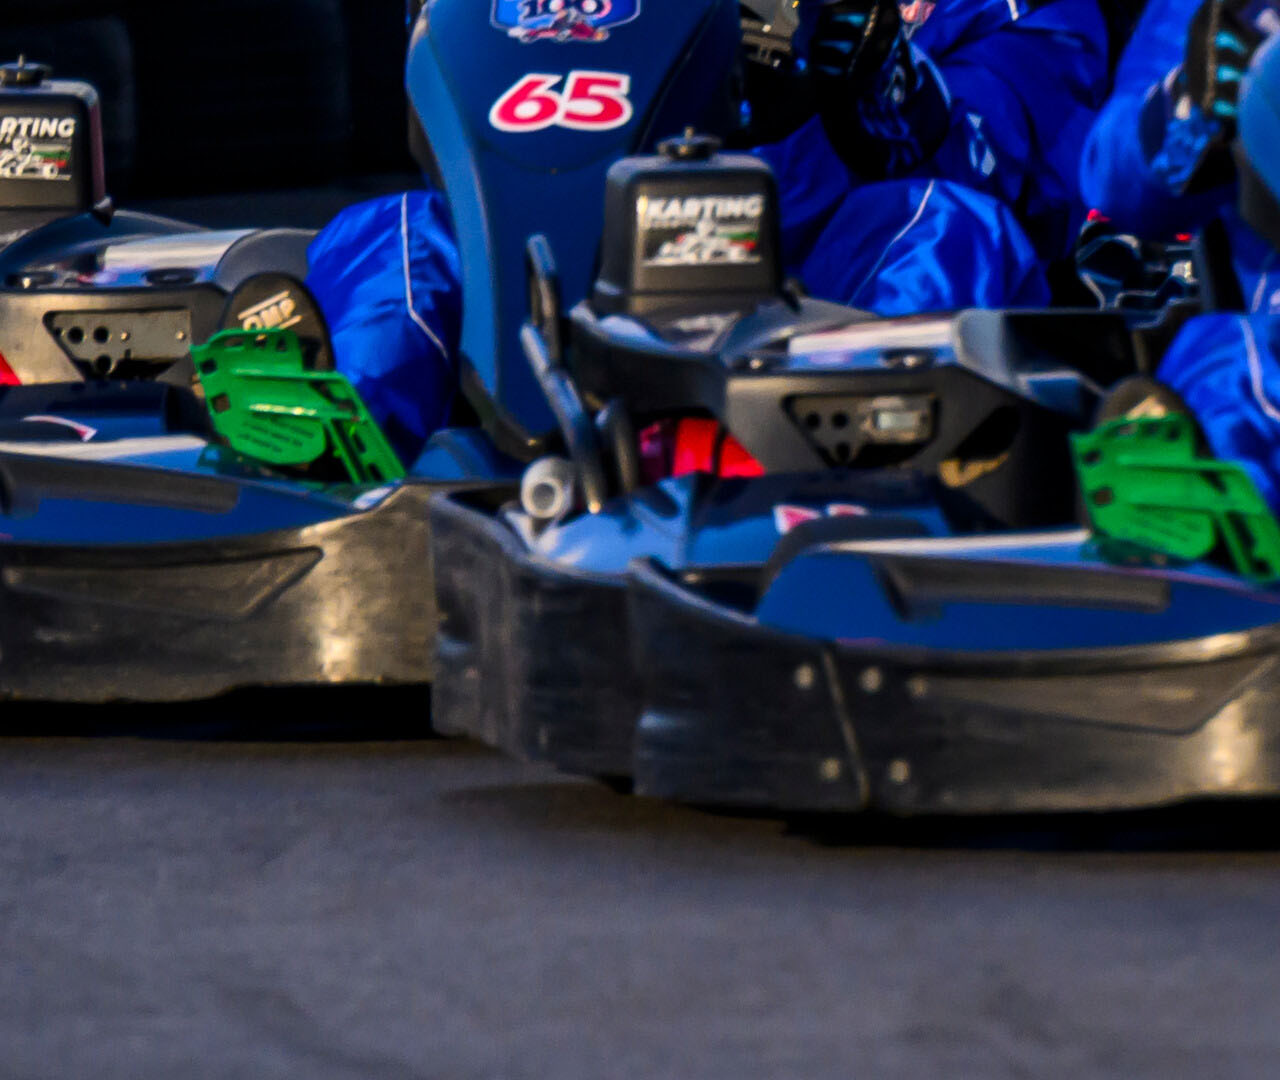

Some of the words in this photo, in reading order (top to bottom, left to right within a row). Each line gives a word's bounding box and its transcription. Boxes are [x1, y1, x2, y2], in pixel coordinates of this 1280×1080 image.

[488, 69, 634, 133] 65
[0, 116, 76, 144] RTING
[644, 195, 764, 218] KARTING
